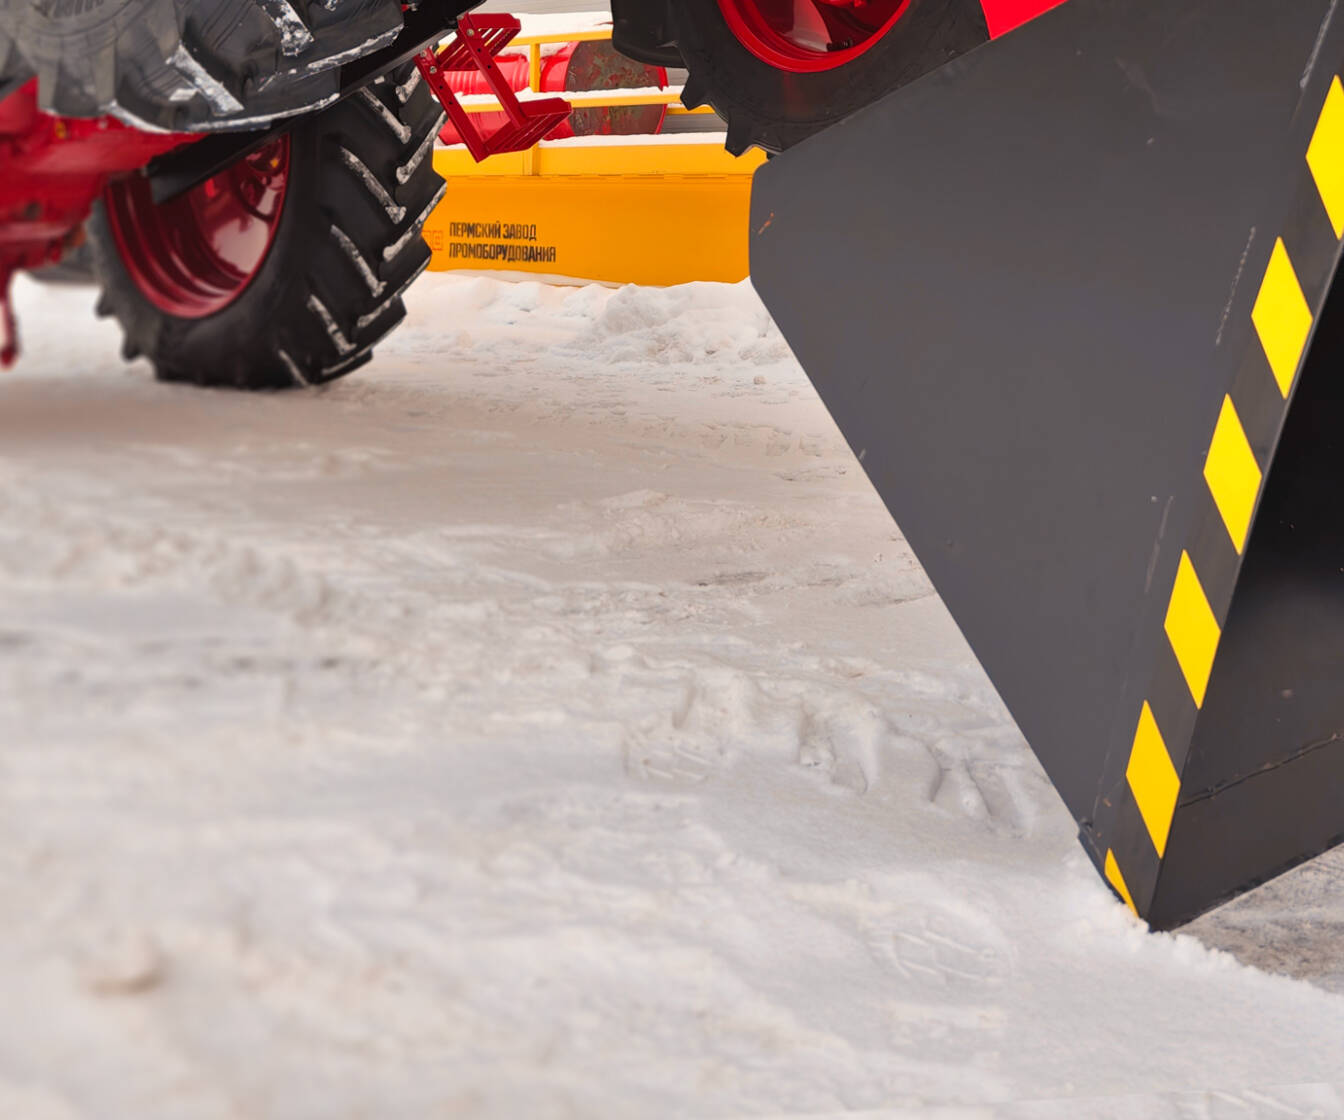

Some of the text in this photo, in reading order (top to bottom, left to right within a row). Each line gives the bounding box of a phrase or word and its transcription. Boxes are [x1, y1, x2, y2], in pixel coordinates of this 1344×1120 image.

[449, 220, 537, 241] ПЕРМСКИЙ ЗАВОД
[449, 242, 556, 263] ПРОМОБОРУДОВАНИЯ
